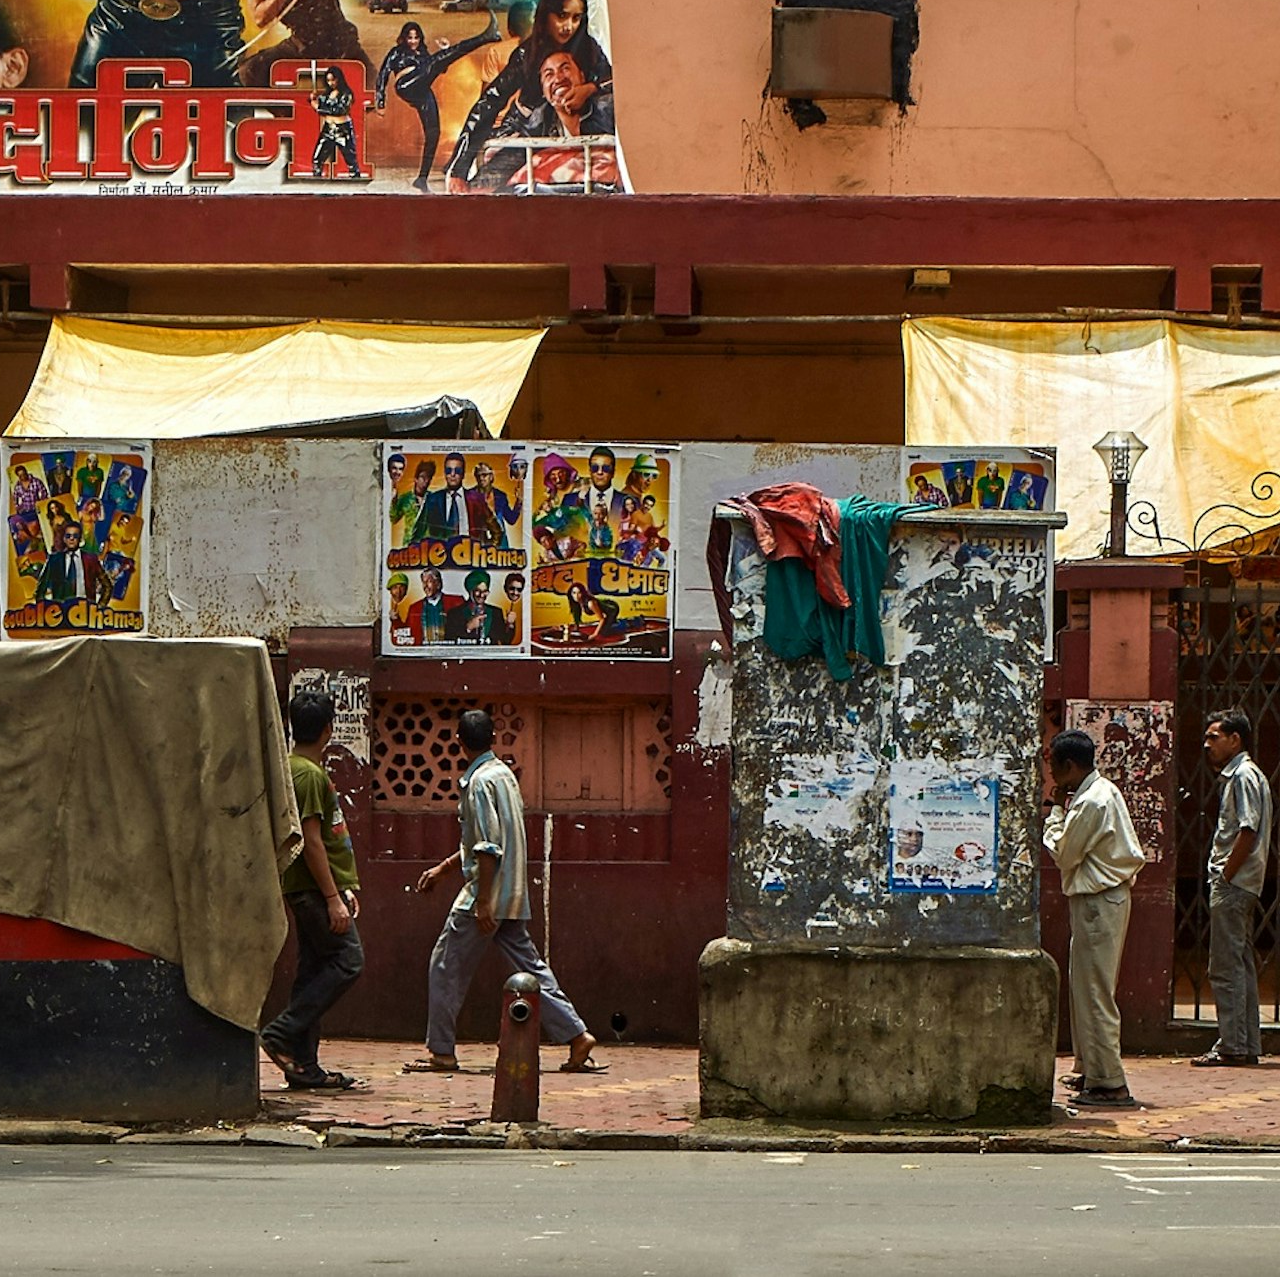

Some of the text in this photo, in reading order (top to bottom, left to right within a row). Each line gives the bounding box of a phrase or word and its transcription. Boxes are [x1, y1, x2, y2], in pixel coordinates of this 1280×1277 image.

[387, 538, 526, 568] double dhamaal
[600, 561, 669, 595] धमाल
[4, 600, 143, 631] double dhamaal
[333, 713, 367, 724] TURDAY
